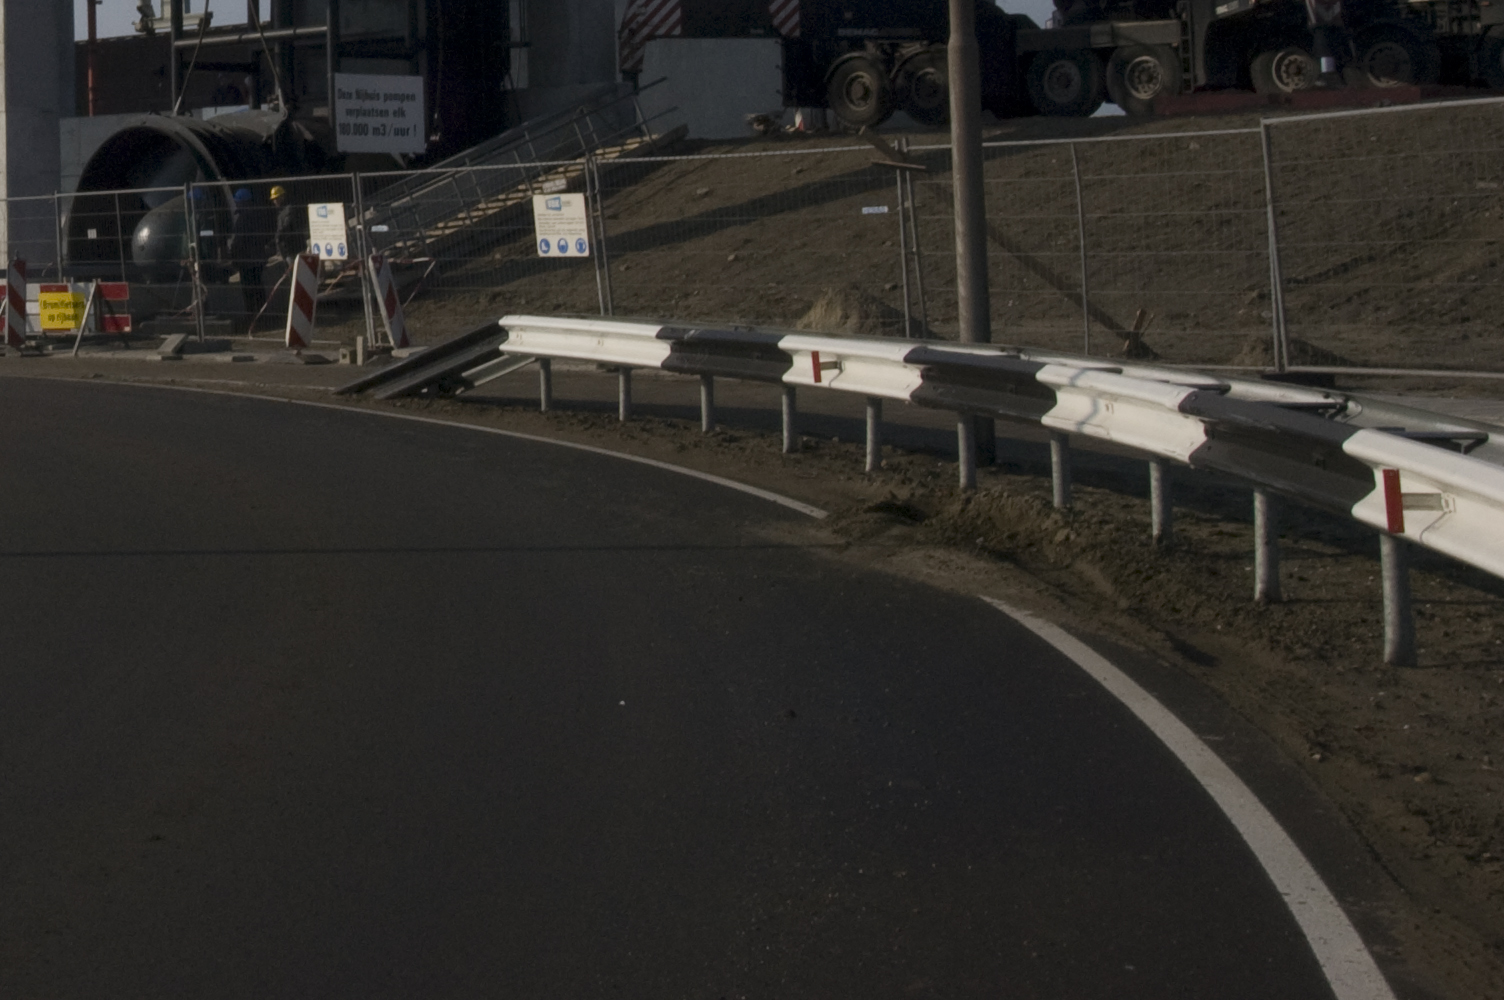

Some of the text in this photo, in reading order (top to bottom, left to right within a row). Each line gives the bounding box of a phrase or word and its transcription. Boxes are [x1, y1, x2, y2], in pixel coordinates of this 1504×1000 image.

[338, 88, 352, 100] Deze
[384, 92, 416, 104] pompen
[346, 106, 406, 118] verplaatsen elk
